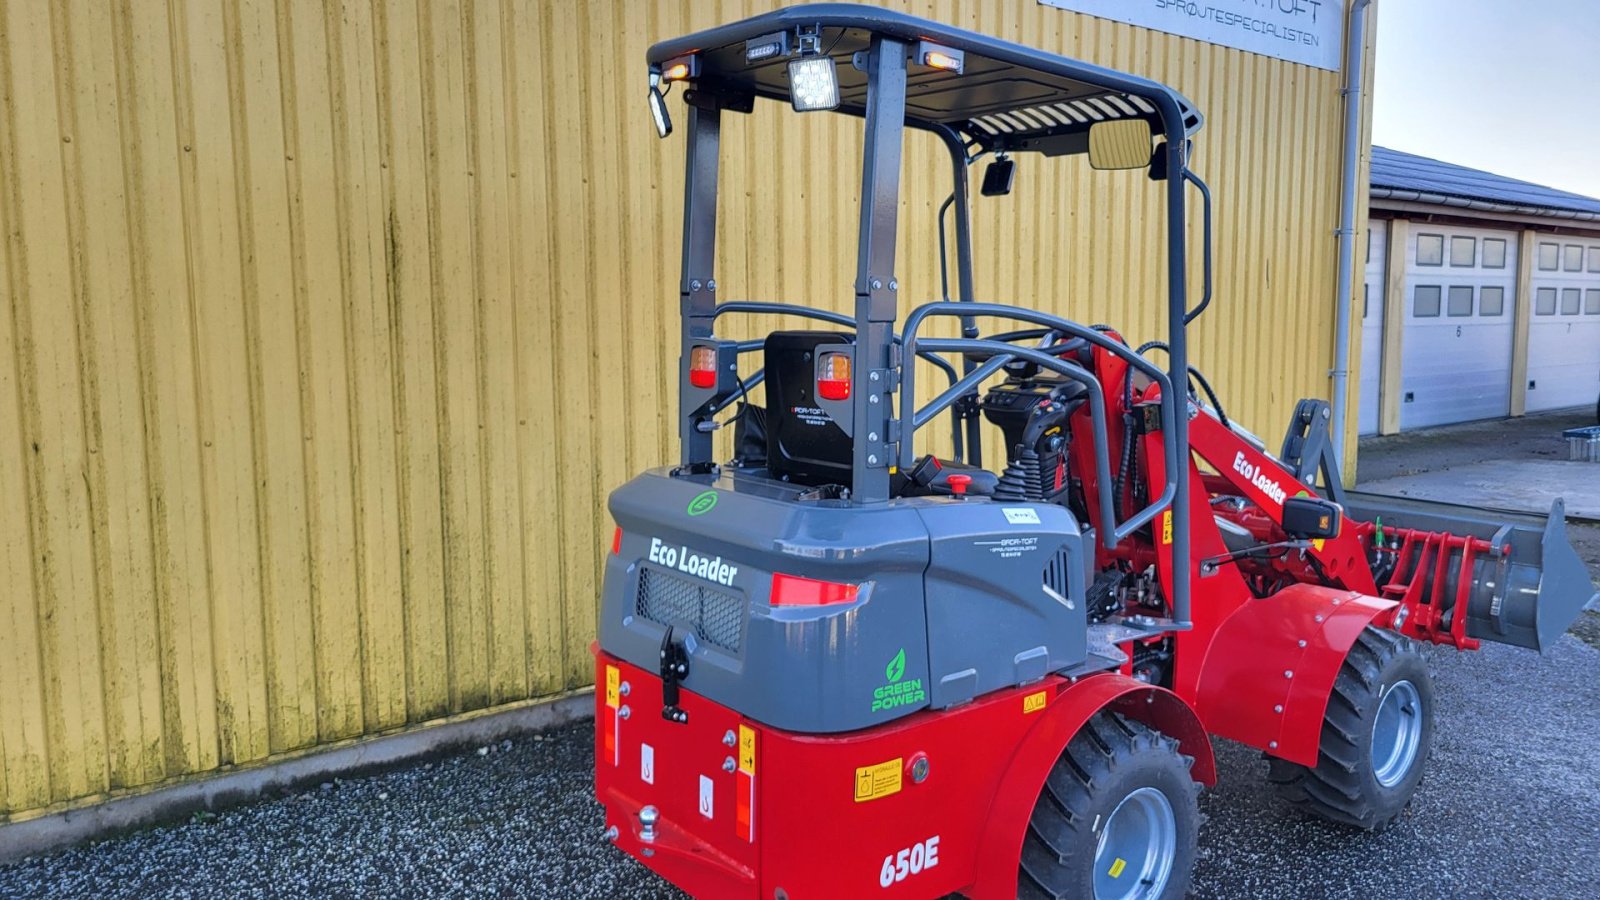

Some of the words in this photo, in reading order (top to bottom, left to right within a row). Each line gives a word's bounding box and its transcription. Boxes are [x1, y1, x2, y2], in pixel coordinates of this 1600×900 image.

[1456, 325, 1462, 338] 6
[1232, 450, 1254, 480] Eco
[1251, 465, 1288, 506] Loader
[648, 537, 677, 568] Eco
[678, 546, 738, 587] Loader
[871, 690, 925, 713] POWER
[873, 678, 921, 700] GREEN
[879, 835, 940, 888] 650E
